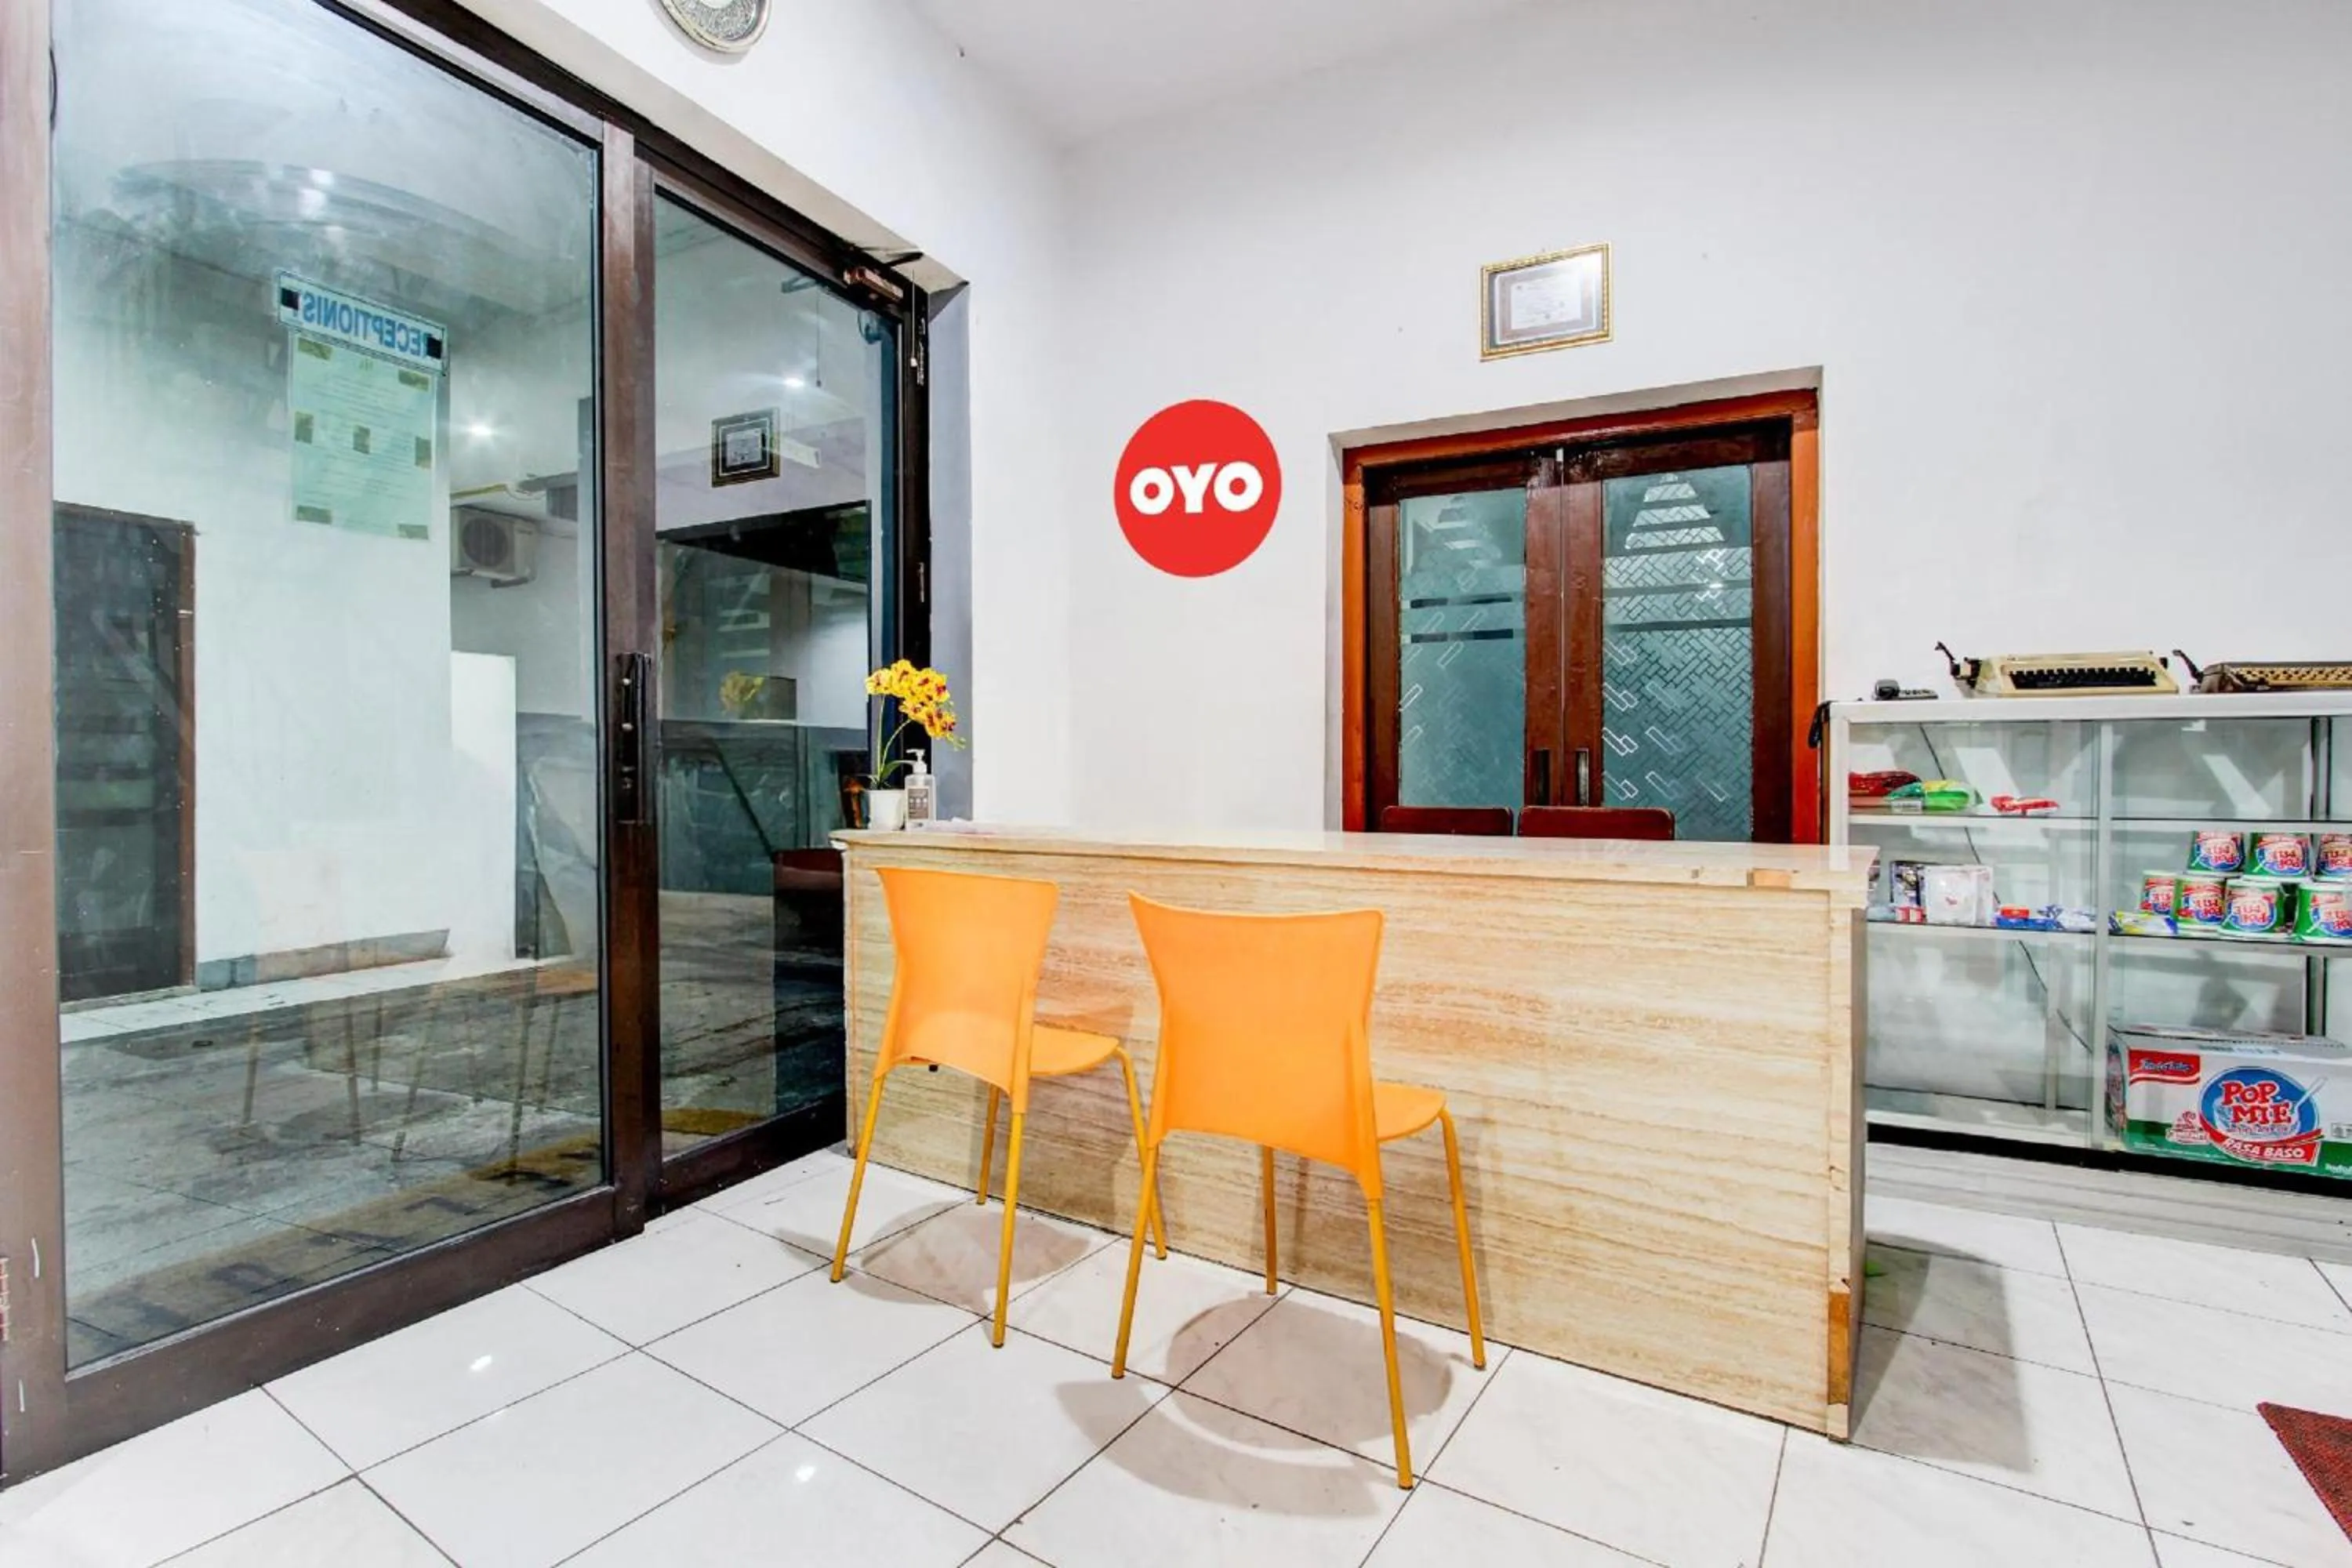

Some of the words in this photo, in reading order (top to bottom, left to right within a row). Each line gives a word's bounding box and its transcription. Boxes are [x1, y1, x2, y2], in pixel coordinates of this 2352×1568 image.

[1130, 461, 1263, 515] OYO
[2221, 1081, 2278, 1105] POP
[2231, 1101, 2292, 1125] MIE
[2223, 1138, 2260, 1155] RASA
[2263, 1146, 2305, 1158] BASO
